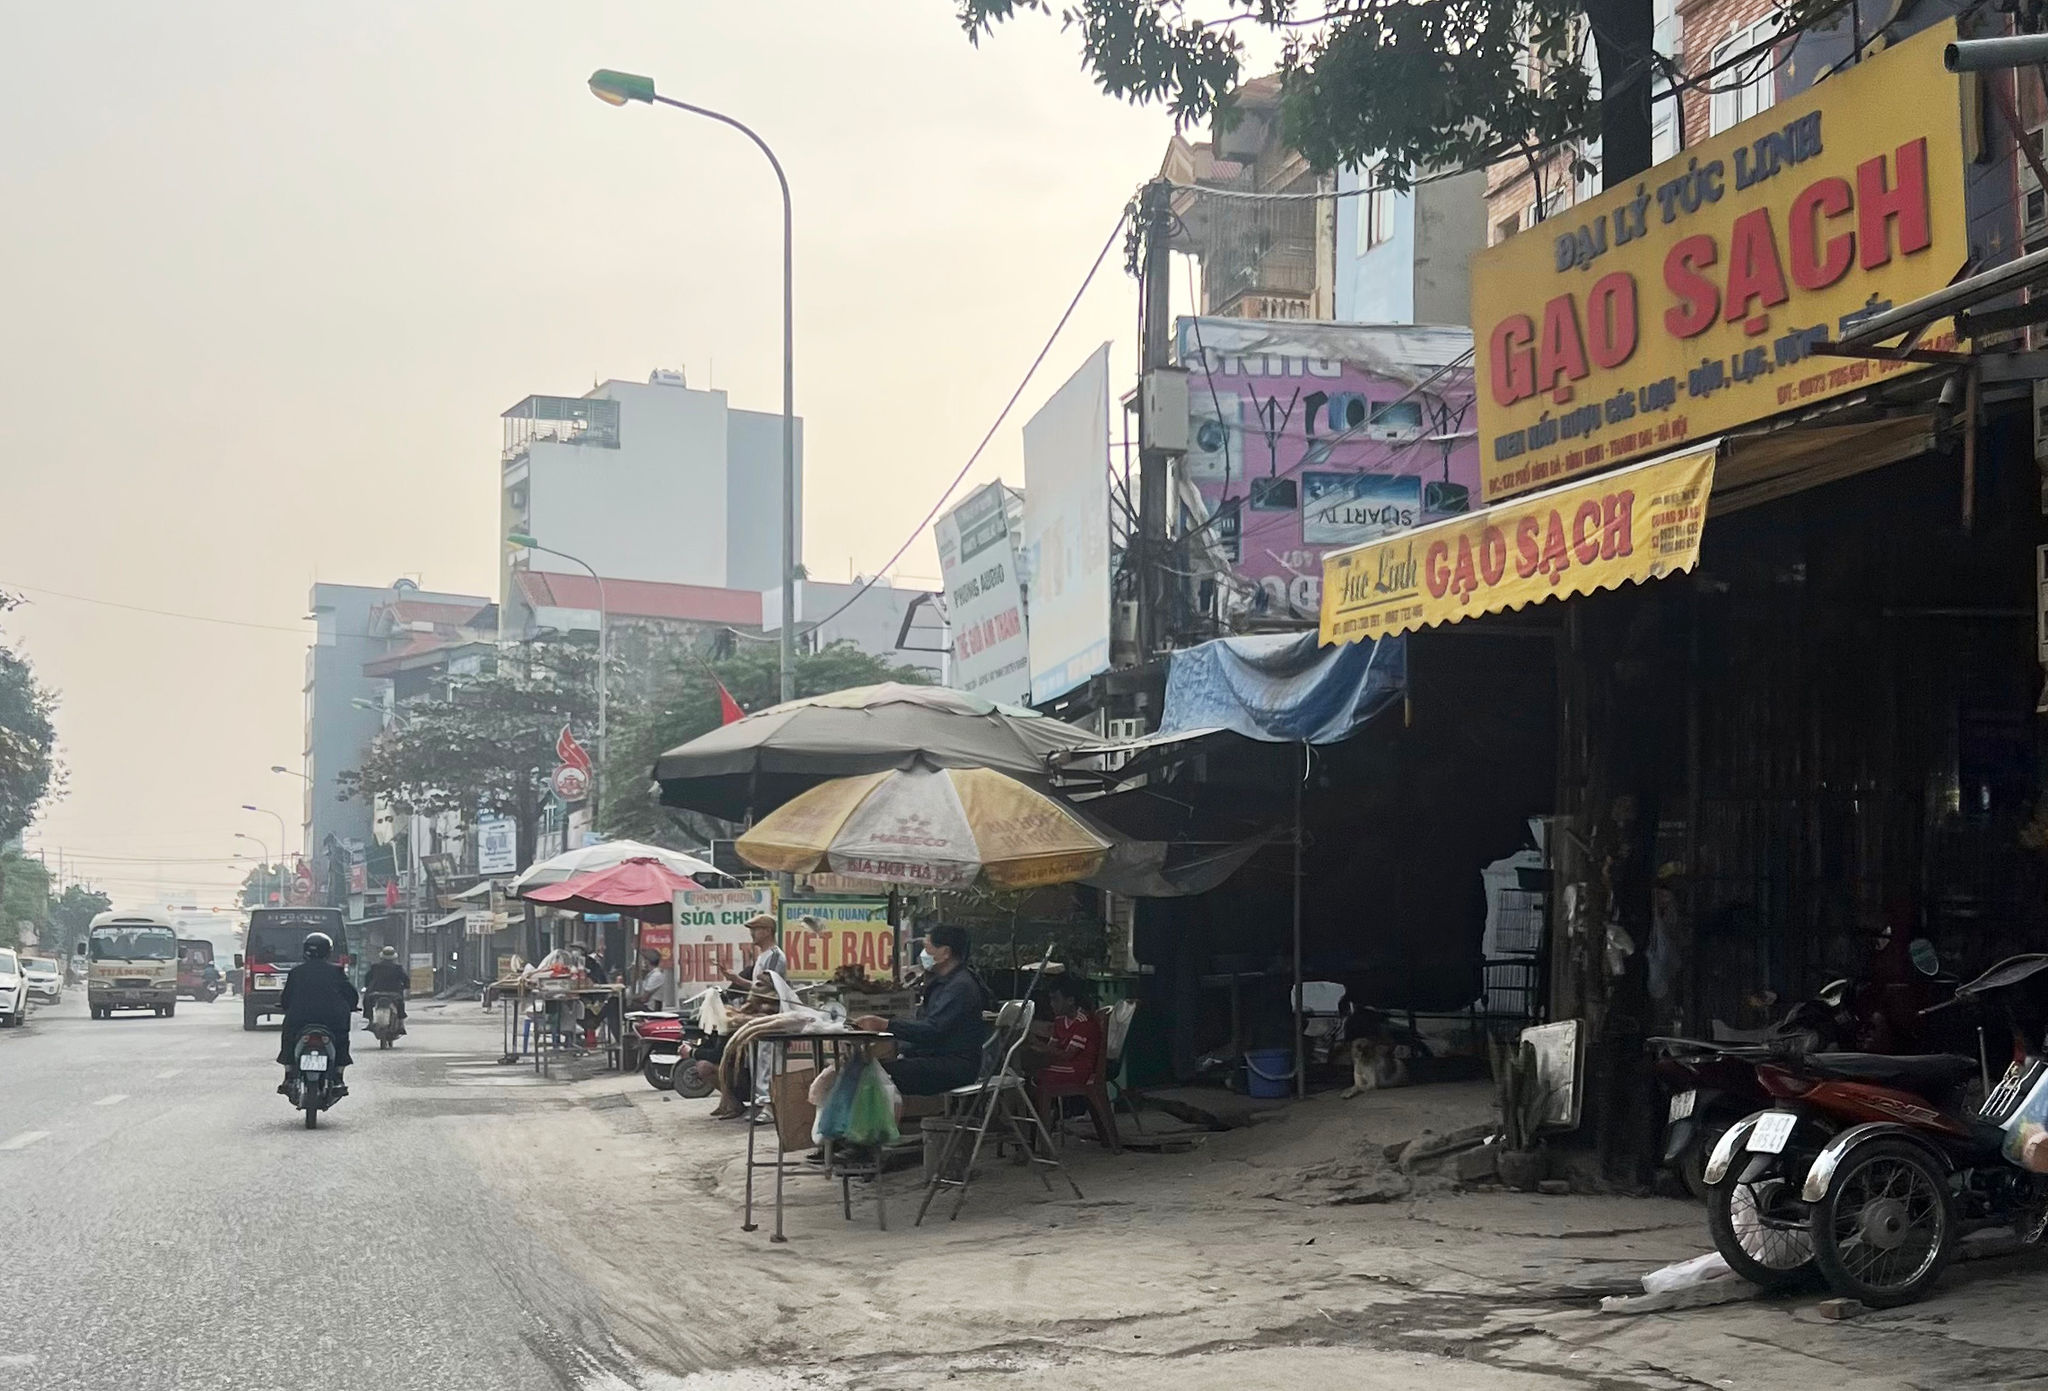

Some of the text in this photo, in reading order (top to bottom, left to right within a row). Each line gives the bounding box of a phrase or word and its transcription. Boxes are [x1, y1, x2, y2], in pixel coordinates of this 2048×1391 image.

[1555, 214, 1608, 272] ĐẠI
[1614, 182, 1652, 246] LÝ
[1733, 111, 1823, 192] LINH
[1489, 137, 1932, 407] GẠO SẠCH
[1605, 387, 1635, 424] CÁC
[1639, 376, 1676, 413] LOẠI
[1319, 509, 1340, 526] TV
[1425, 525, 1506, 605] GẠO
[1515, 489, 1635, 586] SẠCH
[980, 563, 1004, 593] AUDIO
[870, 833, 947, 847] HABECO
[681, 906, 715, 925] SỬA
